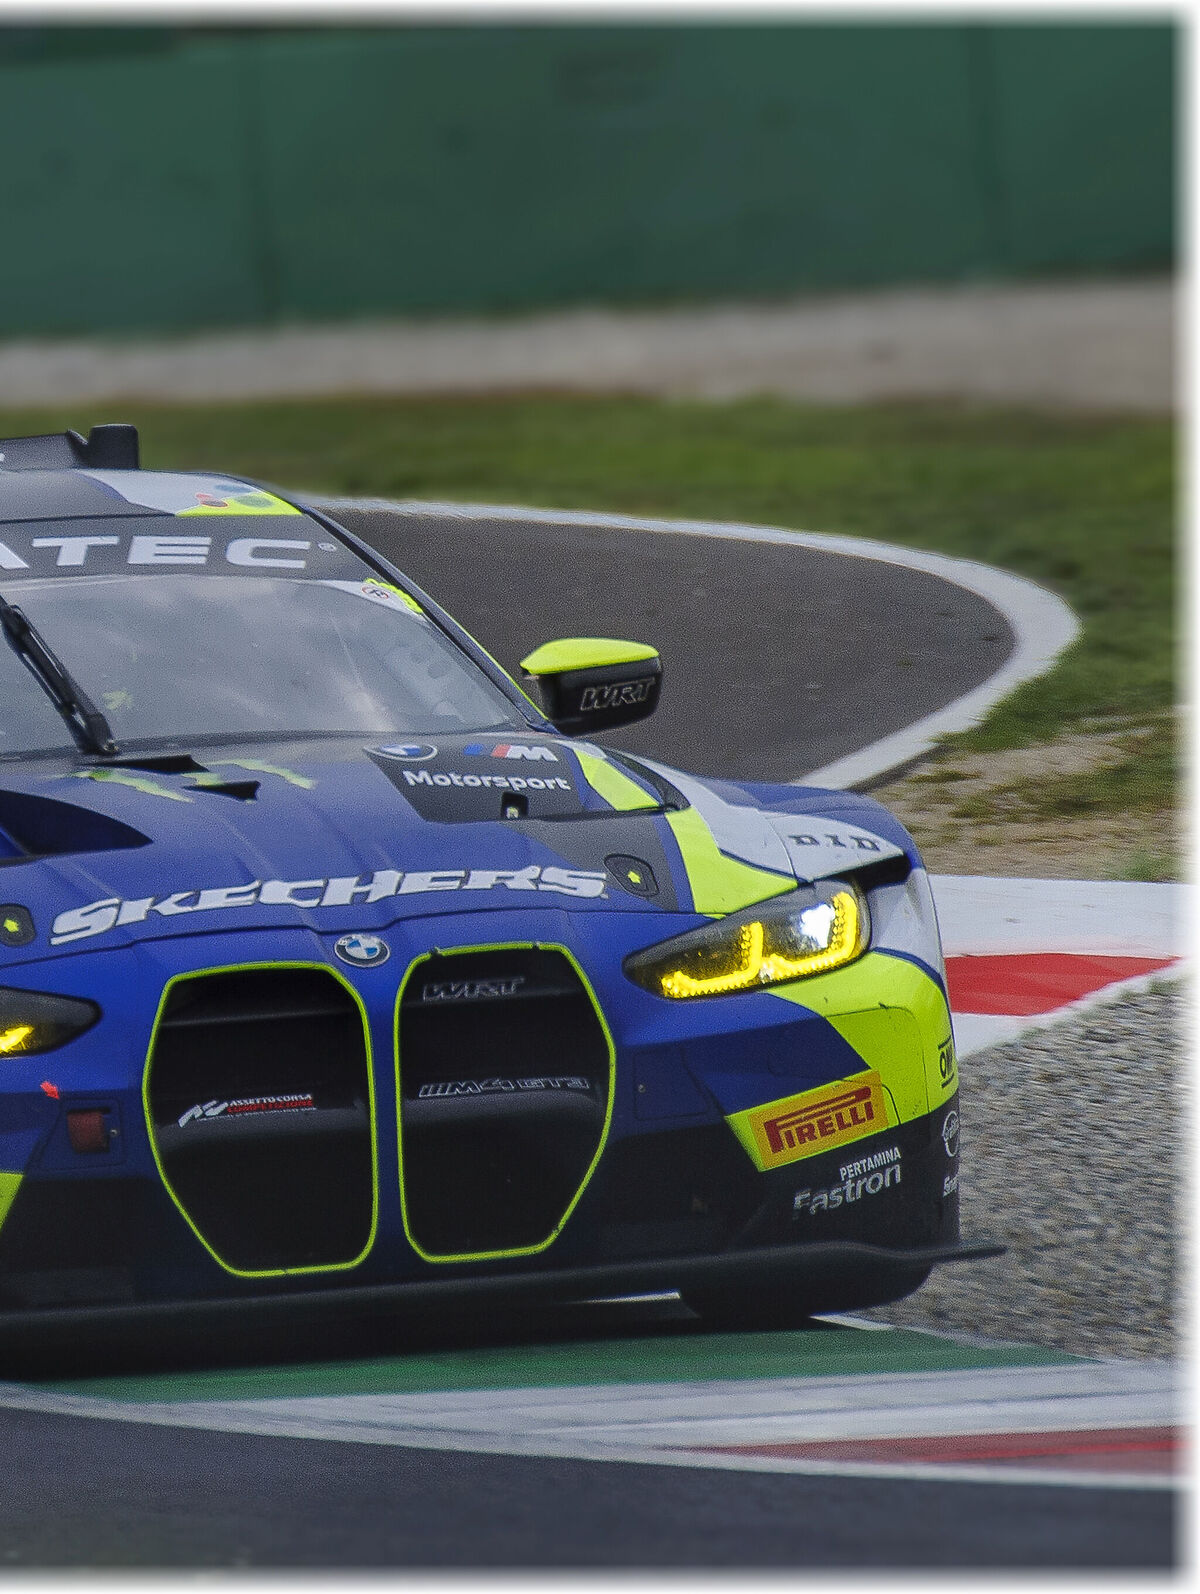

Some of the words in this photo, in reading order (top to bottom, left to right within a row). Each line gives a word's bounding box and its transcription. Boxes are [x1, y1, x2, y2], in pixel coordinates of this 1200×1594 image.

[580, 677, 656, 711] WRT
[402, 770, 571, 791] Motorsport
[50, 866, 609, 946] SKECHERS
[763, 1086, 875, 1154] PIRELLI
[839, 1147, 902, 1182] PERTAMINA
[793, 1164, 901, 1221] Fastron
